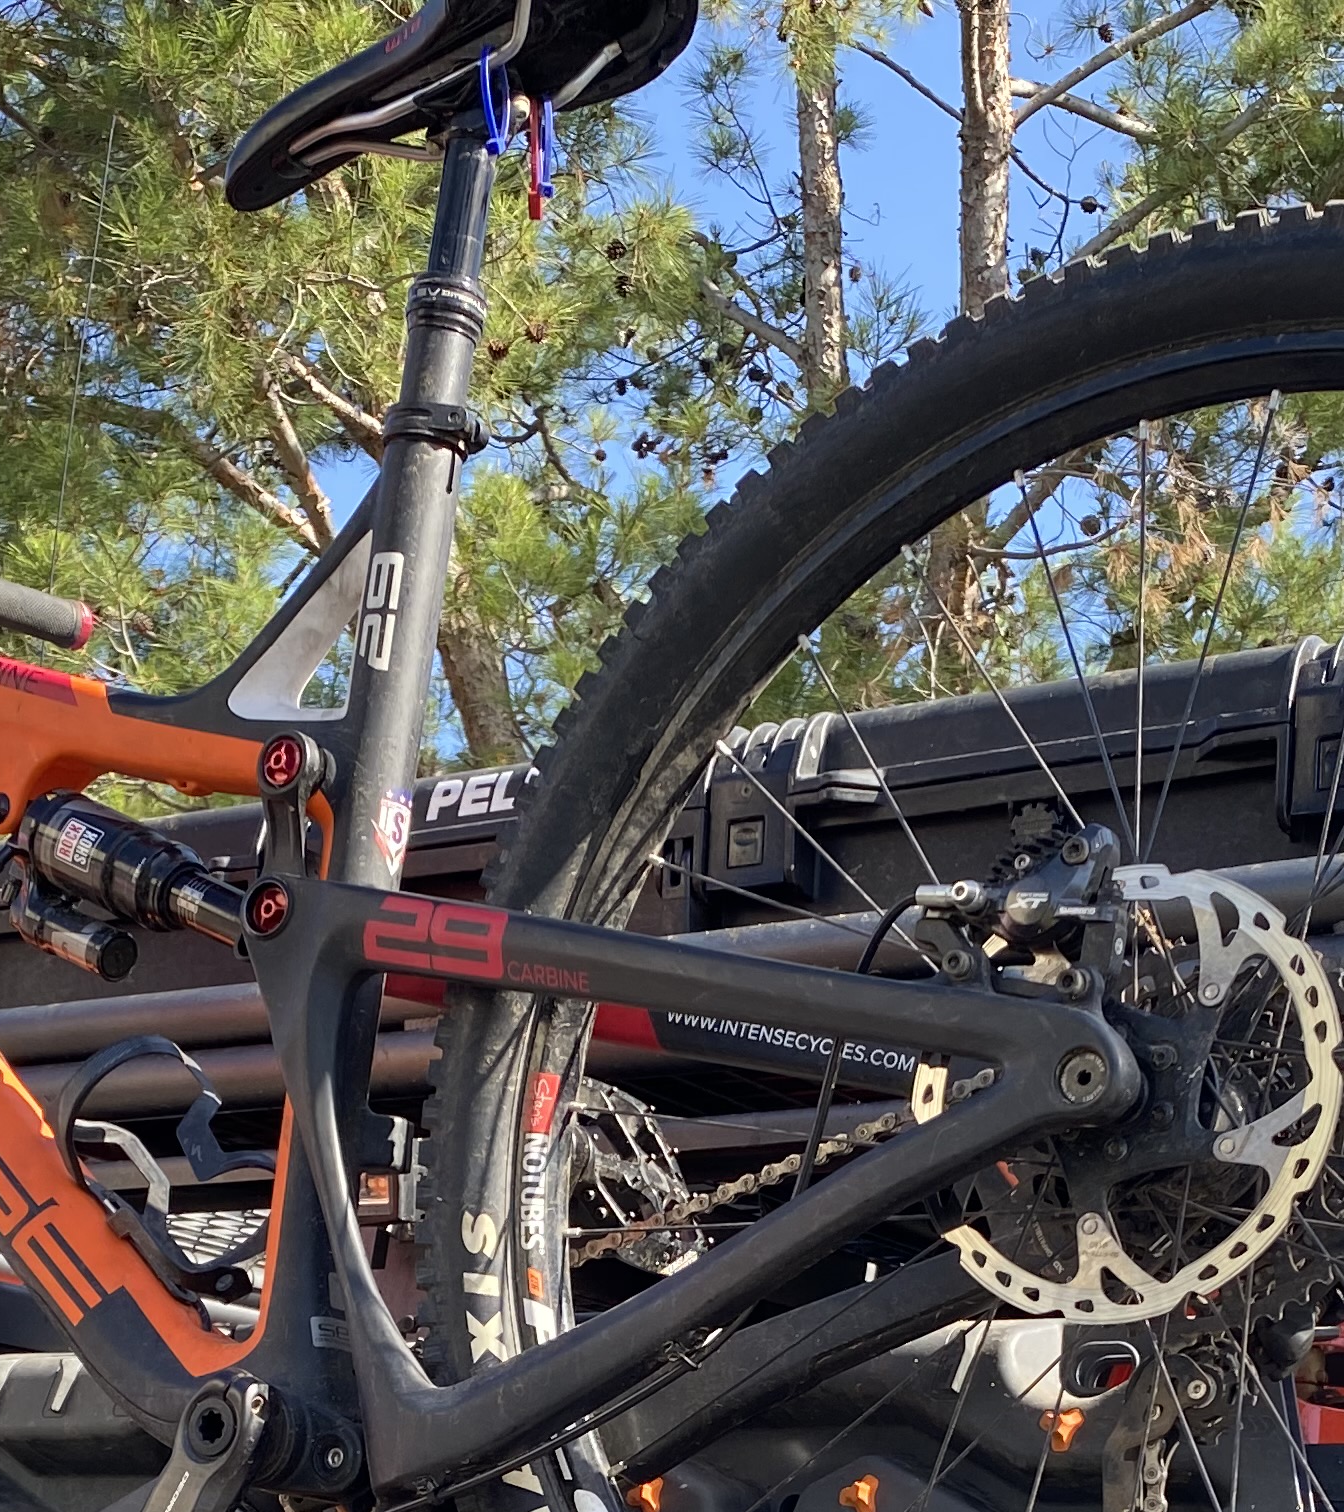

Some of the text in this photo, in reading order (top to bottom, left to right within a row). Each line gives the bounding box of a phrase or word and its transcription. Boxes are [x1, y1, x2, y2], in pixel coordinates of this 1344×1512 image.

[359, 551, 404, 671] 29
[59, 822, 84, 858] ROCK
[72, 829, 99, 866] SHOX
[362, 895, 591, 993] 29 CARBINE
[667, 1011, 916, 1072] WWW.INTENSECYCES.COM
[520, 1131, 549, 1252] NOTUBES
